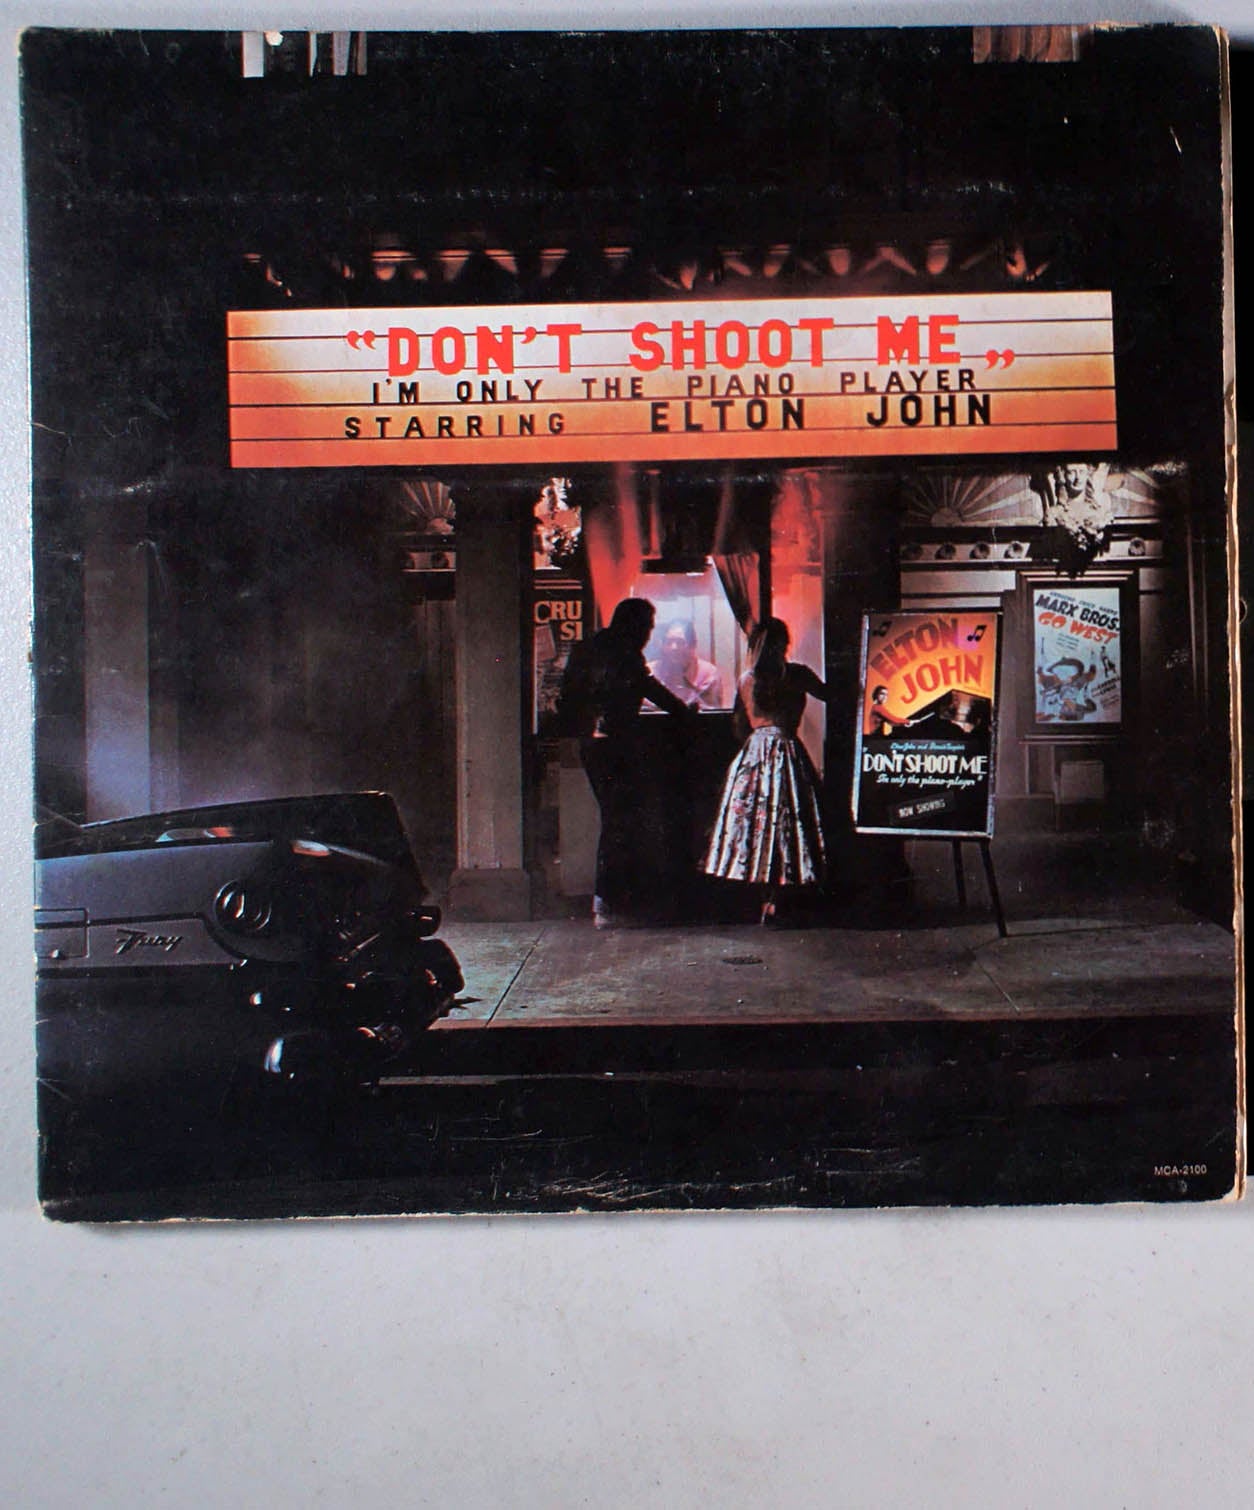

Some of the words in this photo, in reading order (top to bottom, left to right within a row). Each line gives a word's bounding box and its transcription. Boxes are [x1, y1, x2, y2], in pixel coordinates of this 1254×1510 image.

[629, 317, 834, 371] SHOOT
[371, 377, 419, 405] I'M
[456, 378, 543, 403] ONLY
[582, 376, 644, 399] THE
[687, 372, 795, 398] PIANO
[840, 368, 976, 393] PLAYER
[345, 412, 564, 439] STARRING
[650, 397, 805, 433] ELTON
[866, 394, 991, 427] JOHN
[1035, 594, 1079, 617] MARX
[1038, 611, 1067, 629] GO
[1069, 620, 1119, 645] WEST
[869, 617, 959, 682] ELTON
[900, 654, 984, 705] JOHN
[905, 754, 958, 775] SHOOT
[959, 755, 988, 775] ME
[1154, 1164, 1208, 1176] MCA-2100
